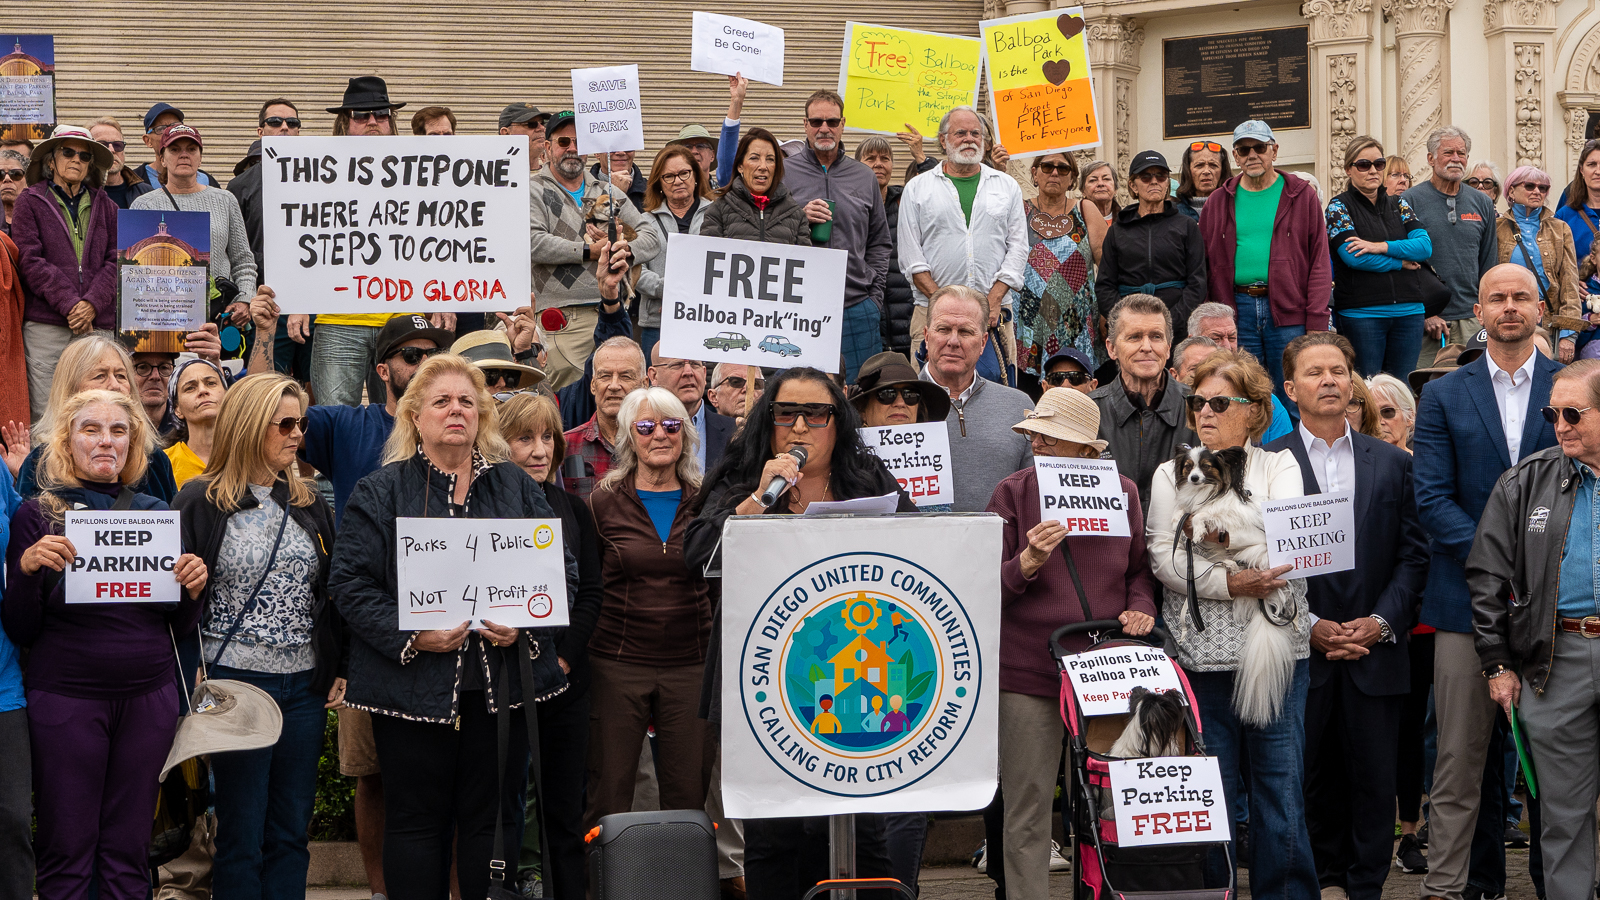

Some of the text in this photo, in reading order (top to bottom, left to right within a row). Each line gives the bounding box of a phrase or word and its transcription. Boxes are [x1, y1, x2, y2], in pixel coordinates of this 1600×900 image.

[723, 25, 755, 39] Greed
[994, 27, 1052, 53] Balboa
[714, 38, 762, 56] Be Gone!
[1033, 44, 1063, 62] Park
[864, 41, 975, 74] Free Balboa
[924, 74, 953, 88] Stop
[999, 64, 1028, 79] is the
[588, 78, 627, 93] SAVE
[917, 87, 932, 97] the
[1002, 85, 1073, 102] of San Diego
[578, 98, 637, 114] BALBOA
[857, 87, 896, 110] Park
[589, 119, 628, 134] PARK
[1017, 105, 1066, 128] FREE
[348, 155, 375, 186] IS
[381, 154, 452, 188] STEP
[280, 200, 486, 229] THERE ARE MORE
[298, 231, 496, 269] STEPS TO COME.
[703, 250, 806, 304] FREE
[423, 279, 507, 302] GLORIA
[673, 301, 737, 325] Balboa
[878, 428, 925, 449] Keep
[882, 450, 943, 472] arking
[1058, 473, 1101, 488] KEEP
[1043, 494, 1123, 511] PARKING
[1266, 496, 1349, 514] PAPILLONS LOVE BALBOA PARK
[1066, 517, 1109, 532] FREE
[1289, 511, 1332, 531] KEEP
[94, 530, 153, 546] KEEP
[400, 532, 534, 562] Parks 4 Public
[1276, 529, 1346, 553] PARKING
[70, 555, 176, 572] PARKING
[1294, 551, 1333, 571] FREE
[95, 581, 152, 598] FREE
[462, 585, 478, 616] 4
[485, 584, 528, 603] Profit
[751, 564, 971, 686] SAN DIEGO UNITED COMMUNITIES
[1069, 651, 1167, 671] Papillons Love
[1079, 665, 1161, 684] Balboa Park
[1082, 692, 1110, 703] Keep
[758, 701, 963, 784] CALLING FOR CITY REFORM
[1136, 761, 1192, 782] Keep
[1121, 784, 1215, 807] Parking
[1132, 810, 1212, 836] FREE
